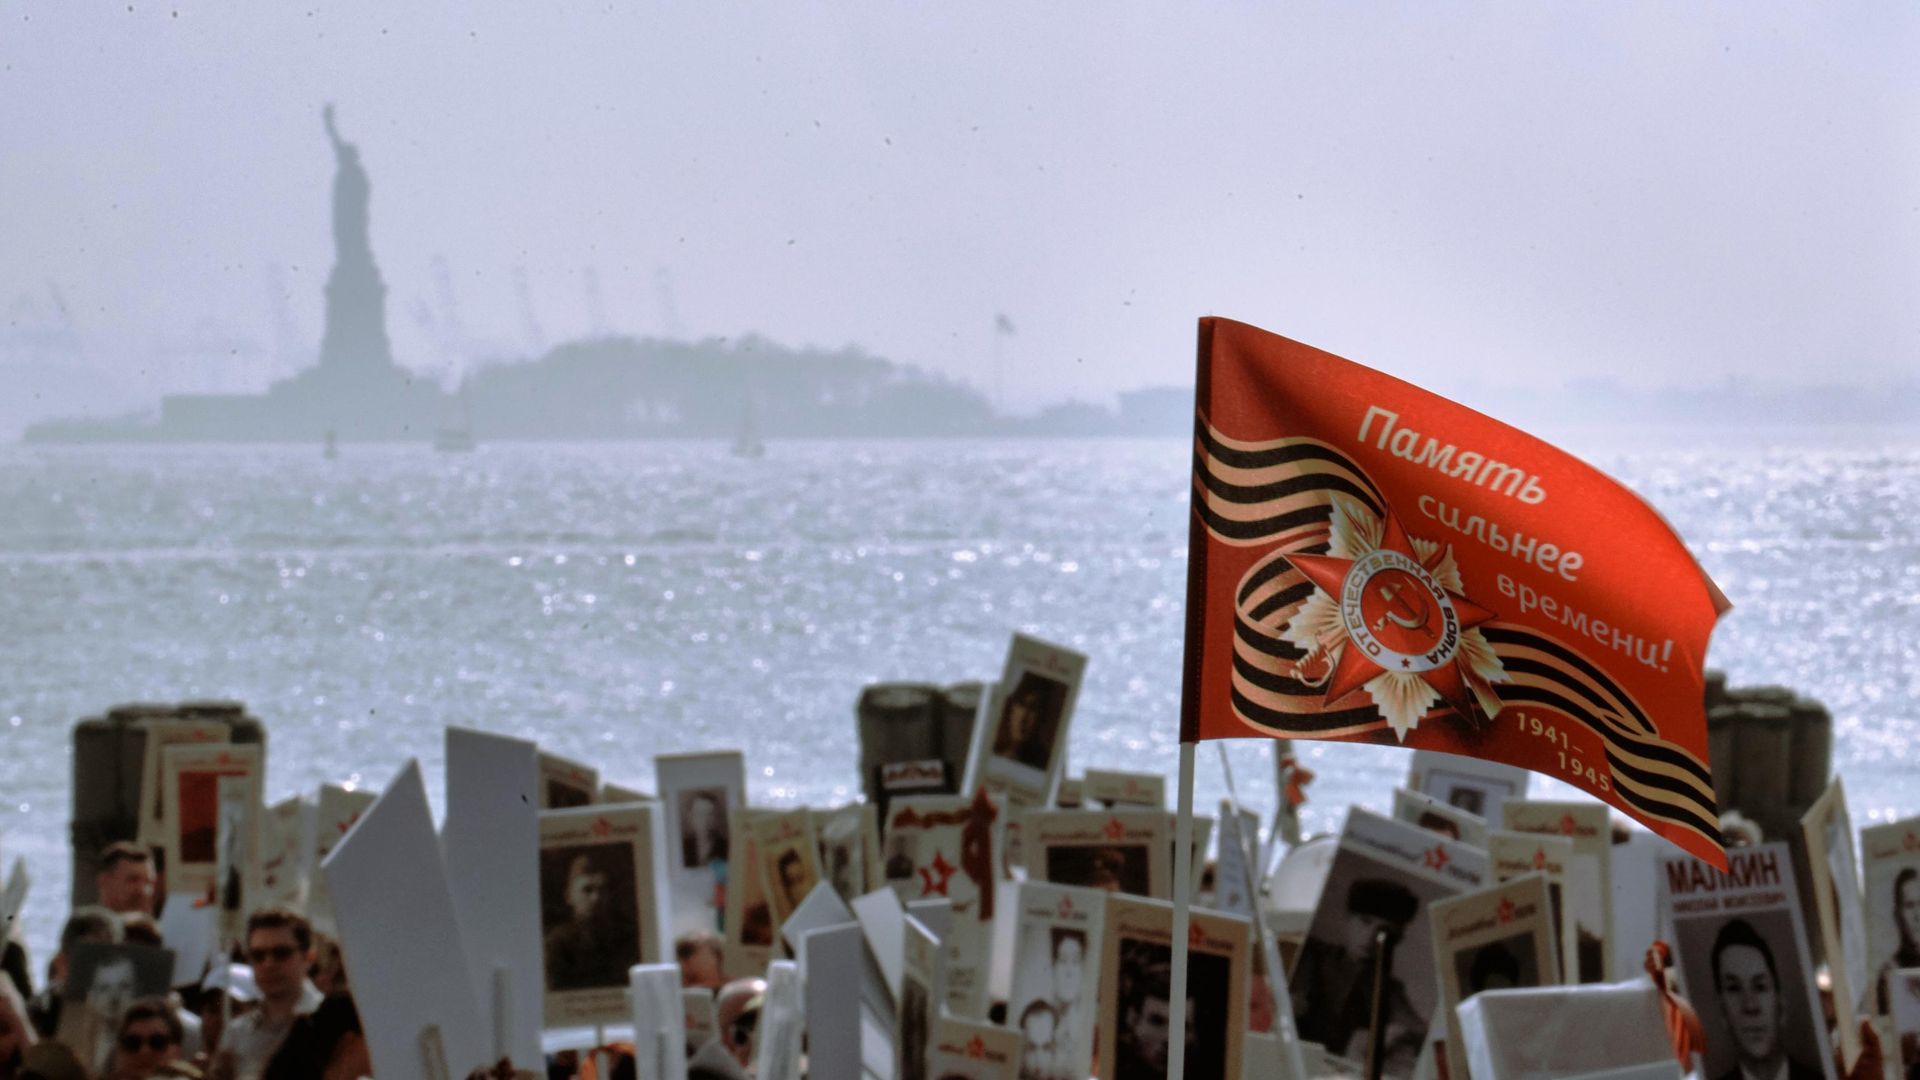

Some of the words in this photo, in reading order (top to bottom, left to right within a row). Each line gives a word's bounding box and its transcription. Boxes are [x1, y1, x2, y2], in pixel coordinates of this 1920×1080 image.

[1357, 404, 1547, 505] Память
[1418, 494, 1585, 582] сильнее
[1496, 573, 1675, 672] времени!
[1558, 751, 1611, 792] 1945
[1665, 851, 1780, 895] МАЛКИН
